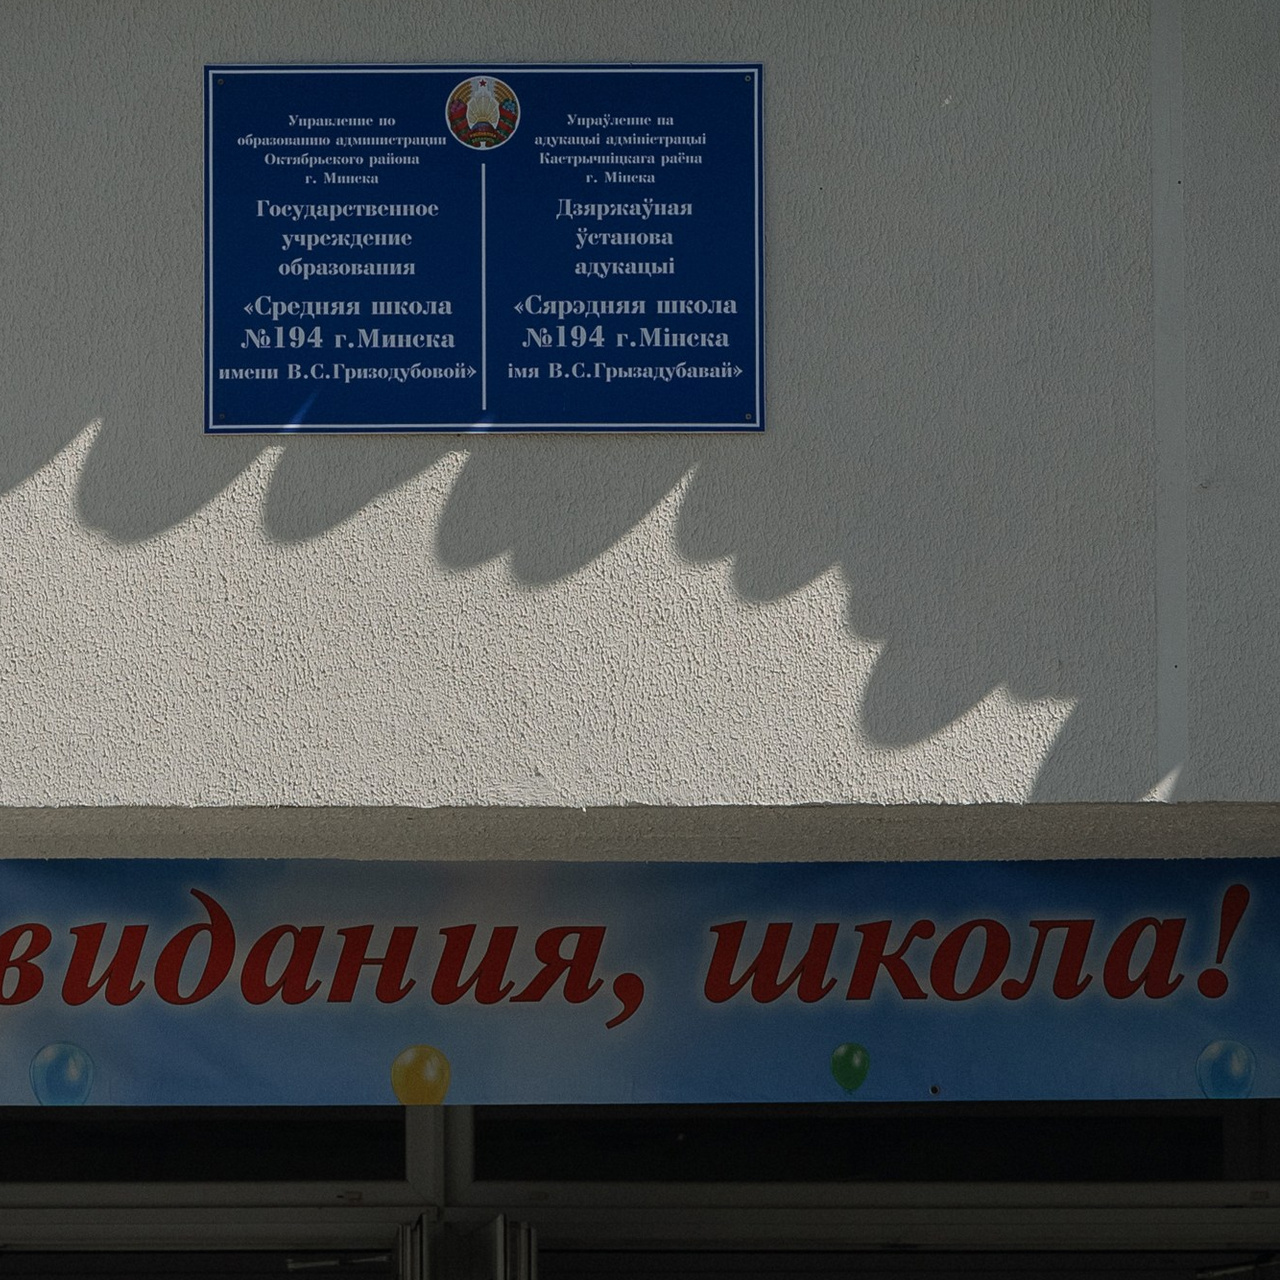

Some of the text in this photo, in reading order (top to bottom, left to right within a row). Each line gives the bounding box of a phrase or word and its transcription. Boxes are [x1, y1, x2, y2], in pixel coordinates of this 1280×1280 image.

[288, 114, 396, 130] Управление по
[657, 117, 674, 126] па
[237, 133, 447, 149] образованию администрации
[534, 132, 706, 148] адукацыі адміністрацыі
[264, 152, 420, 168] Октябрьского района
[661, 152, 702, 167] раёна
[305, 172, 379, 184] г. Минска
[586, 171, 656, 183] г. Мінска
[257, 199, 439, 222] Государственное
[555, 198, 693, 221] Дзяржаўная
[281, 233, 412, 251] учреждение
[575, 227, 673, 250] ўстанова
[278, 257, 415, 280] образования
[574, 257, 675, 279] адукацыі
[243, 295, 453, 321] «Средняя школа
[513, 294, 738, 320] «Сярэдняя школа
[240, 326, 323, 349] №194
[522, 325, 605, 348] №194
[219, 368, 278, 380] имени
[508, 362, 539, 379] імя
[705, 886, 1248, 1003] школа!
